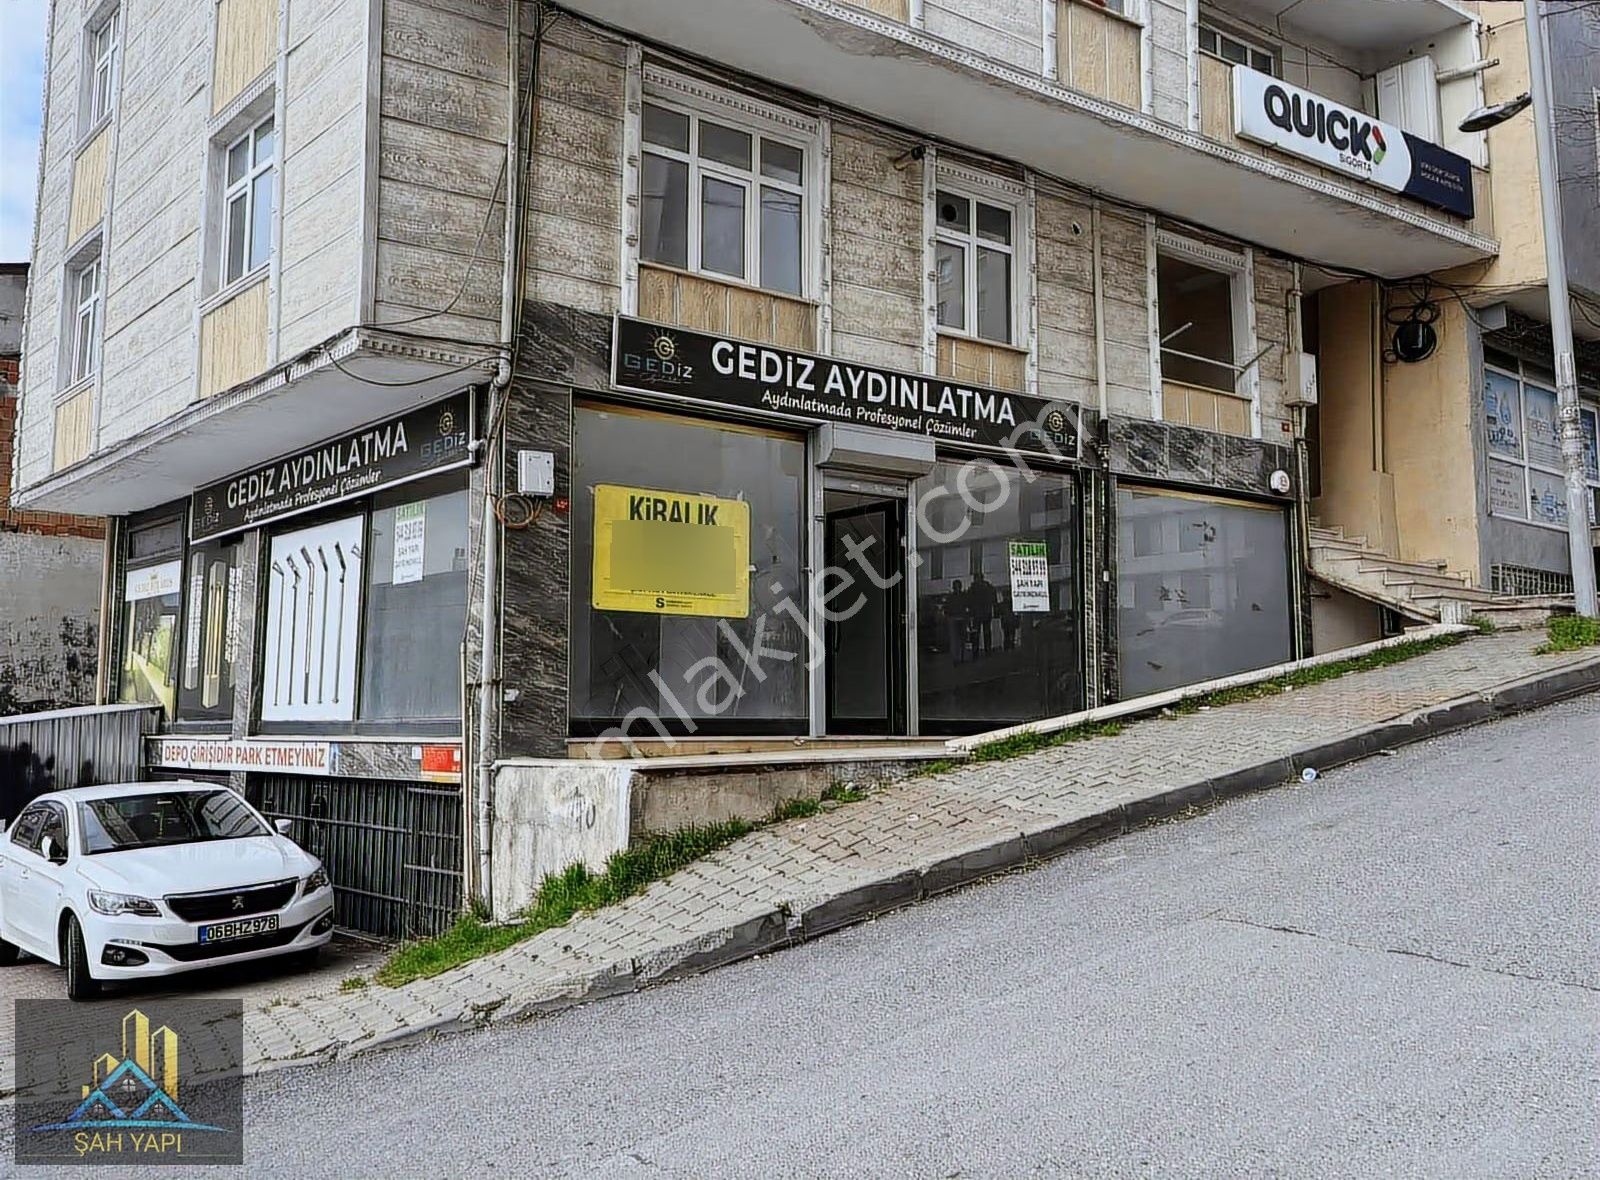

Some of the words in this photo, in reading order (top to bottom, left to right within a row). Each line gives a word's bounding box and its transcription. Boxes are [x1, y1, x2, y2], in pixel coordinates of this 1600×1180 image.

[1263, 84, 1372, 162] QUICK
[761, 389, 851, 418] Aydınlatmada
[856, 406, 922, 431] Profesyonel
[925, 418, 978, 440] Çözümler
[823, 364, 1016, 427] AYDINLATMA
[279, 422, 408, 493] AYDINLATMA
[164, 745, 188, 762] DEPO
[236, 746, 263, 765] PARK
[265, 743, 326, 768] ETMEYİNİZ
